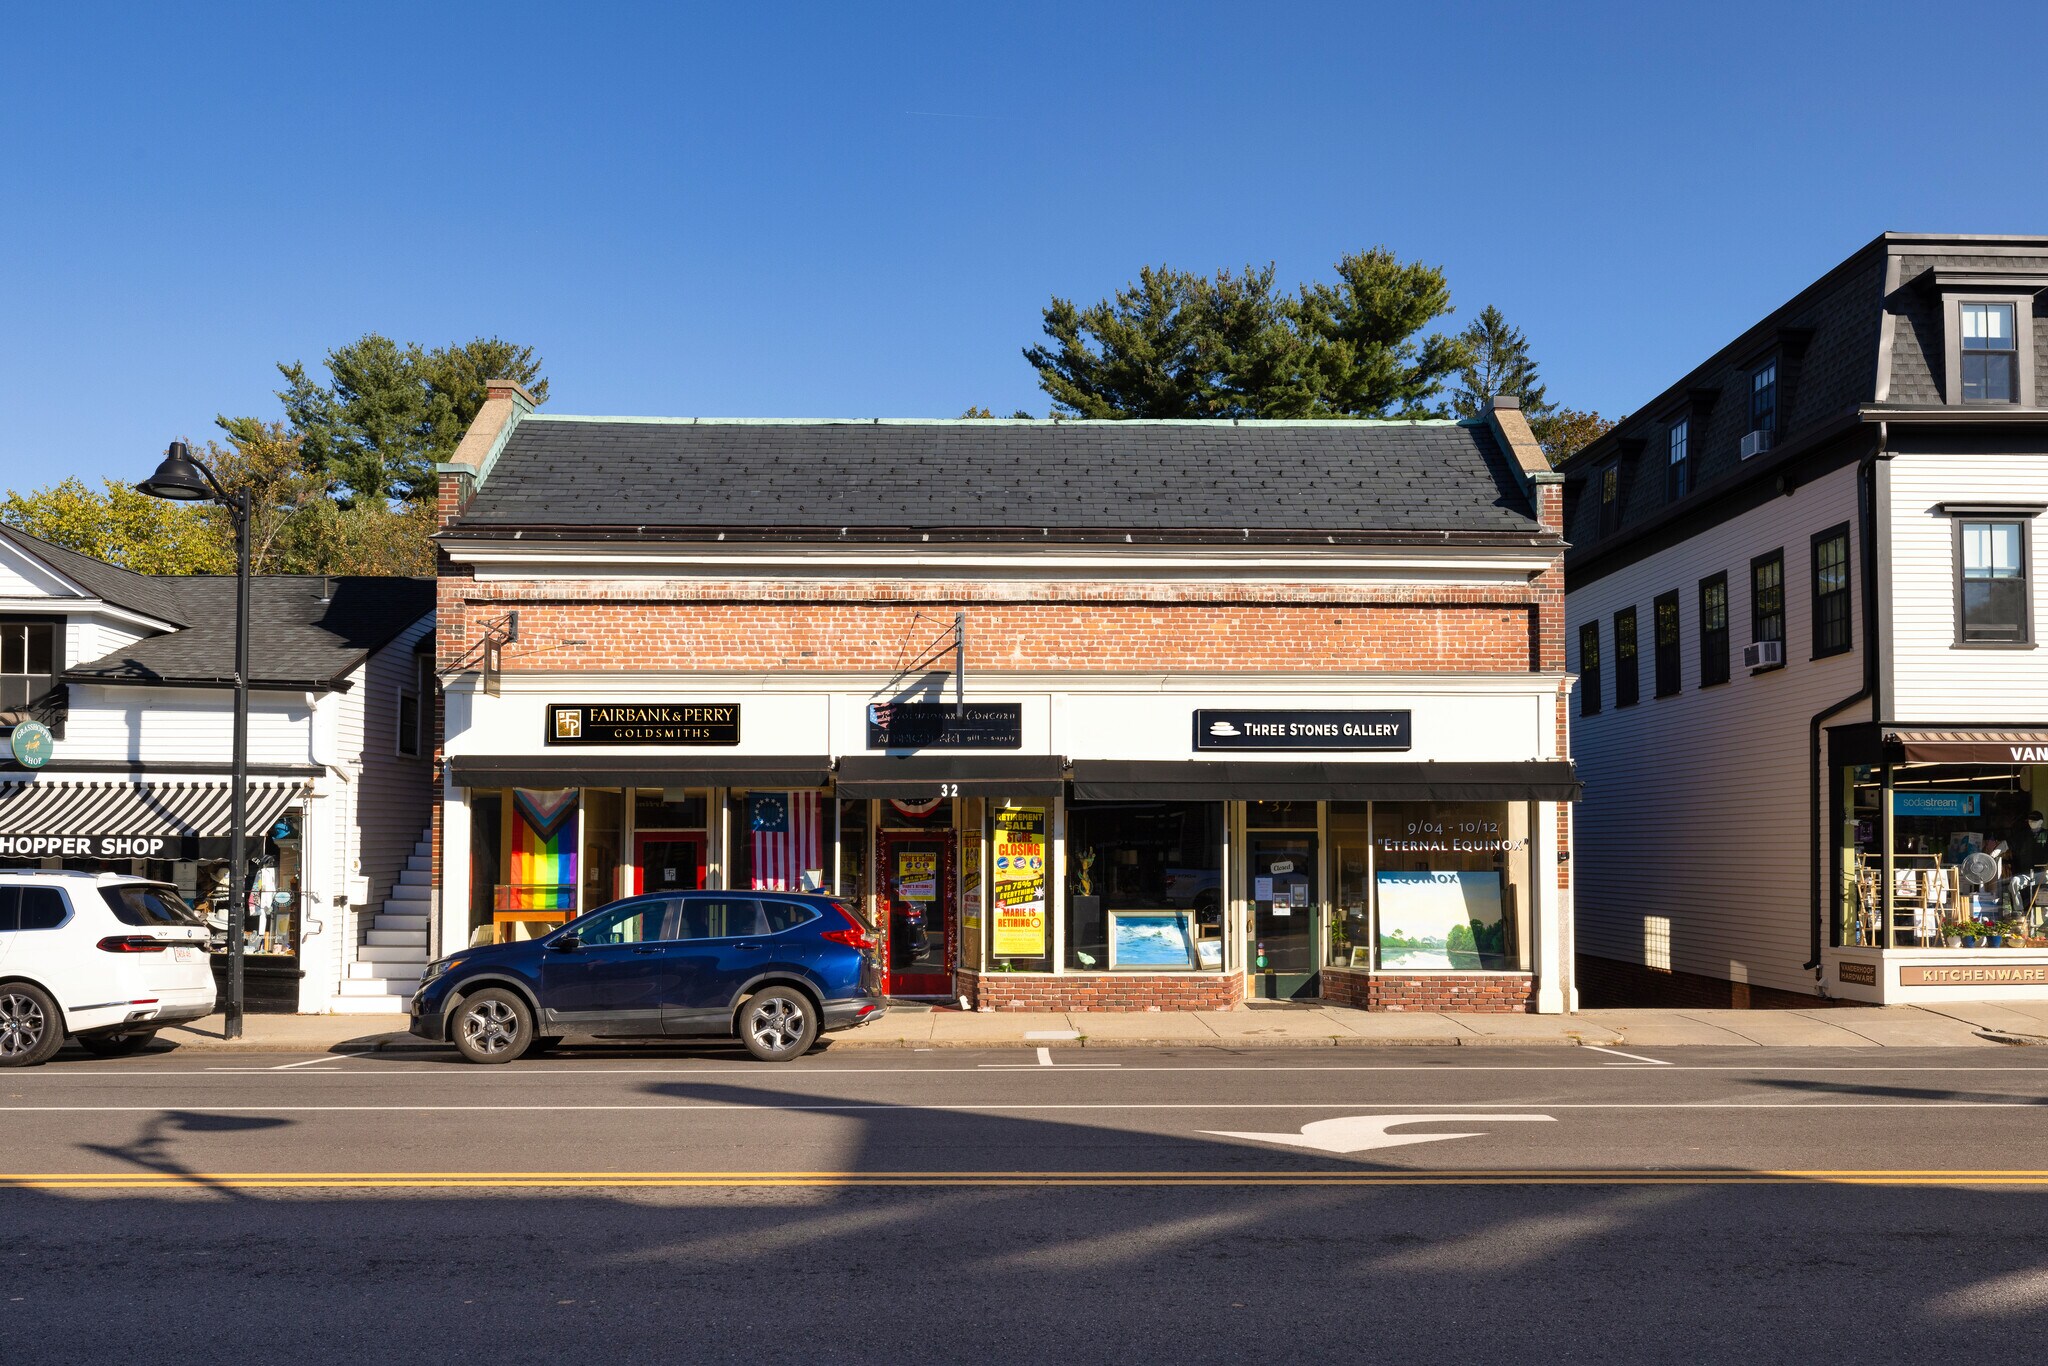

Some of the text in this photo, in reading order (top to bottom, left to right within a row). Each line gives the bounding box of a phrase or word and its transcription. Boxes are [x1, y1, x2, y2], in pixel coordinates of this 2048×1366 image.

[590, 708, 734, 722] FAIRBANK & PERRY
[614, 728, 710, 738] GOLDSMITHS
[1244, 722, 1400, 736] THREE STONES GALLERY
[2010, 746, 2048, 761] VAN
[24, 755, 42, 766] SHOP
[941, 784, 958, 797] 32
[1903, 797, 1957, 807] sodastream
[996, 813, 1043, 821] RETIREMENT
[1005, 821, 1034, 830] SALE
[1407, 819, 1443, 835] 9/04
[1458, 819, 1498, 834] 10/12
[1007, 832, 1033, 843] STORE
[0, 837, 164, 855] HOPPER SHOP
[998, 843, 1041, 856] CLOSING
[1273, 864, 1291, 873] Closed
[1012, 880, 1032, 890] 75%
[1000, 887, 1035, 899] EVERYTHING
[1006, 897, 1024, 905] MUST
[1002, 908, 1036, 917] MARIE IS
[997, 918, 1031, 927] RETIRING
[1840, 963, 1875, 974] VANDERHOOF
[1840, 972, 1874, 983] HARDWARE
[1922, 968, 2046, 982] KITCHENWARE
